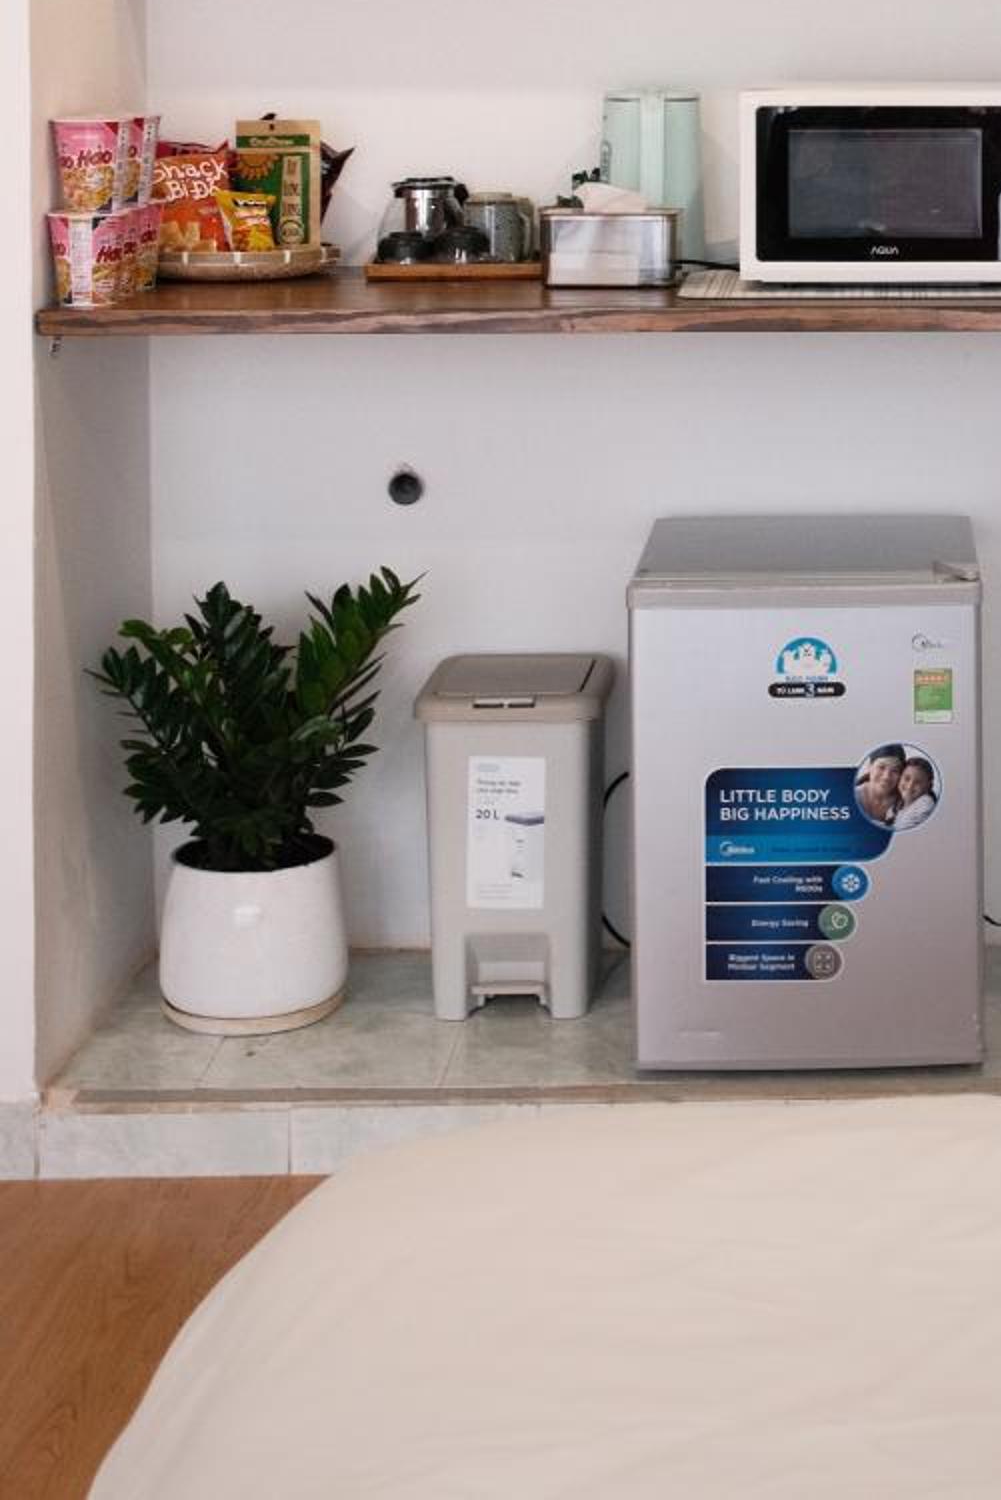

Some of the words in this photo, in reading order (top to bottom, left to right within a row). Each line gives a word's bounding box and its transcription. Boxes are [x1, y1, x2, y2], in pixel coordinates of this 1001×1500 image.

[805, 683, 815, 698] 3
[719, 789, 777, 803] LITTLE
[781, 789, 830, 803] BODY
[719, 807, 749, 821] BIG
[755, 807, 850, 821] HAPPINESS
